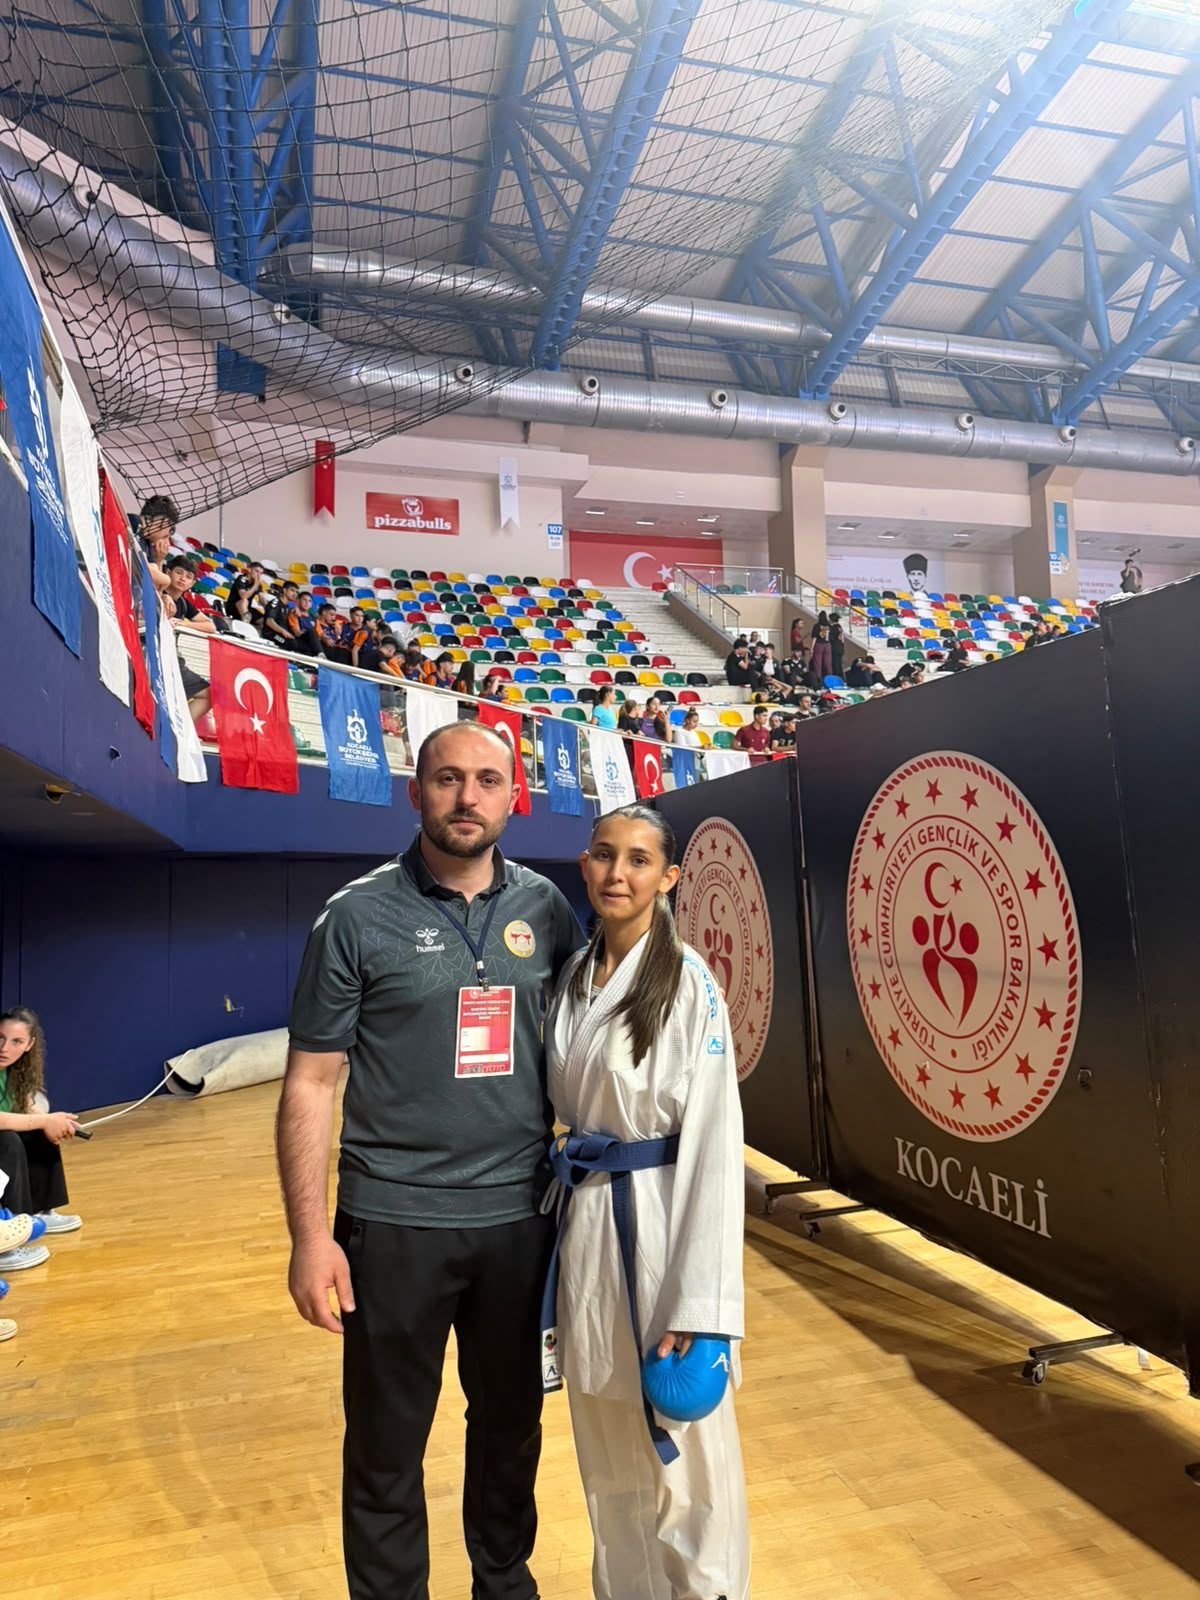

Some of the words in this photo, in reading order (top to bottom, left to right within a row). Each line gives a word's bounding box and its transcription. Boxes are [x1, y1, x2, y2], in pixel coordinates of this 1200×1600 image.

[374, 514, 452, 531] pizzabulls
[549, 526, 562, 534] 107
[917, 824, 979, 858] GENÇLİK
[980, 850, 1000, 882] VE
[690, 873, 707, 946] MHURİYETİ
[707, 868, 733, 892] GENÇLİK
[733, 886, 741, 906] VE
[739, 907, 750, 951] SPOR
[880, 833, 916, 969] CUMHURİYETİ
[995, 882, 1022, 949] SPOR
[416, 942, 446, 953] hummel
[889, 973, 936, 1052] TÜRKİYE
[971, 957, 1023, 1061] BAKANLIĞI
[894, 1136, 1052, 1239] KOCAELİ
